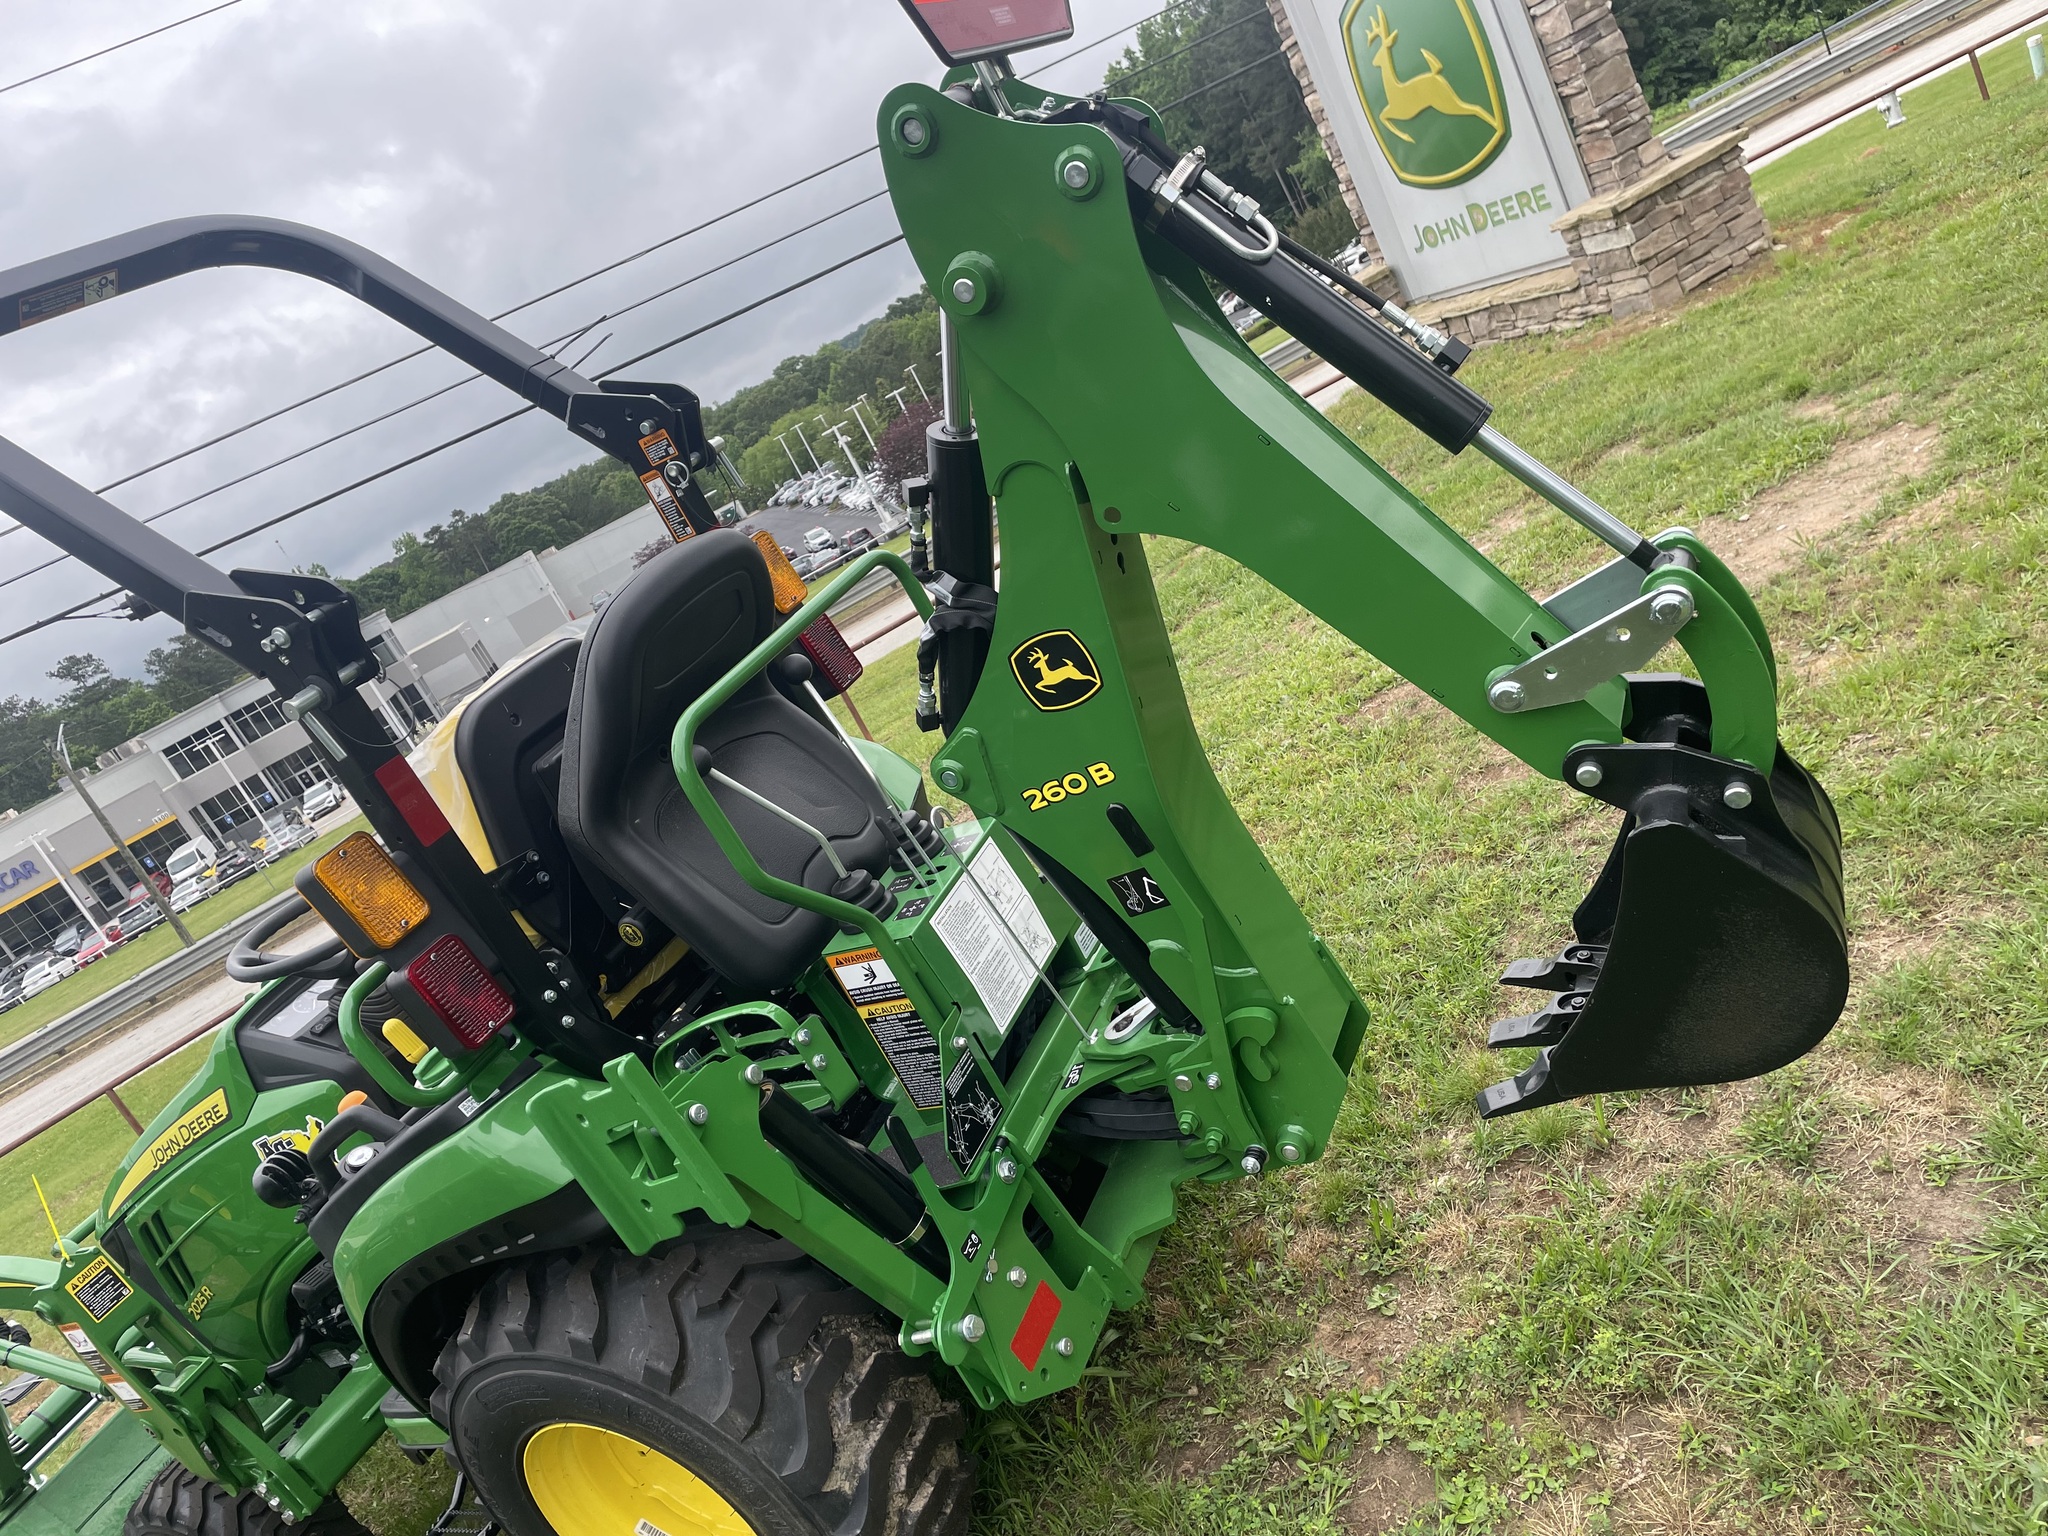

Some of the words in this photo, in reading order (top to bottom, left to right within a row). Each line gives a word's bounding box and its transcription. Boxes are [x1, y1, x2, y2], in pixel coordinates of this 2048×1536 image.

[1414, 213, 1470, 253] JOHN
[1466, 184, 1552, 234] DEERE
[1021, 772, 1089, 812] 260
[1086, 761, 1116, 787] B
[0, 860, 40, 893] CAR
[875, 1003, 913, 1015] CAUTION
[150, 1139, 181, 1169] JOHN
[178, 1104, 224, 1147] DEERE
[77, 1259, 105, 1284] CAUTION
[187, 1292, 208, 1321] 2025
[200, 1285, 214, 1300] R
